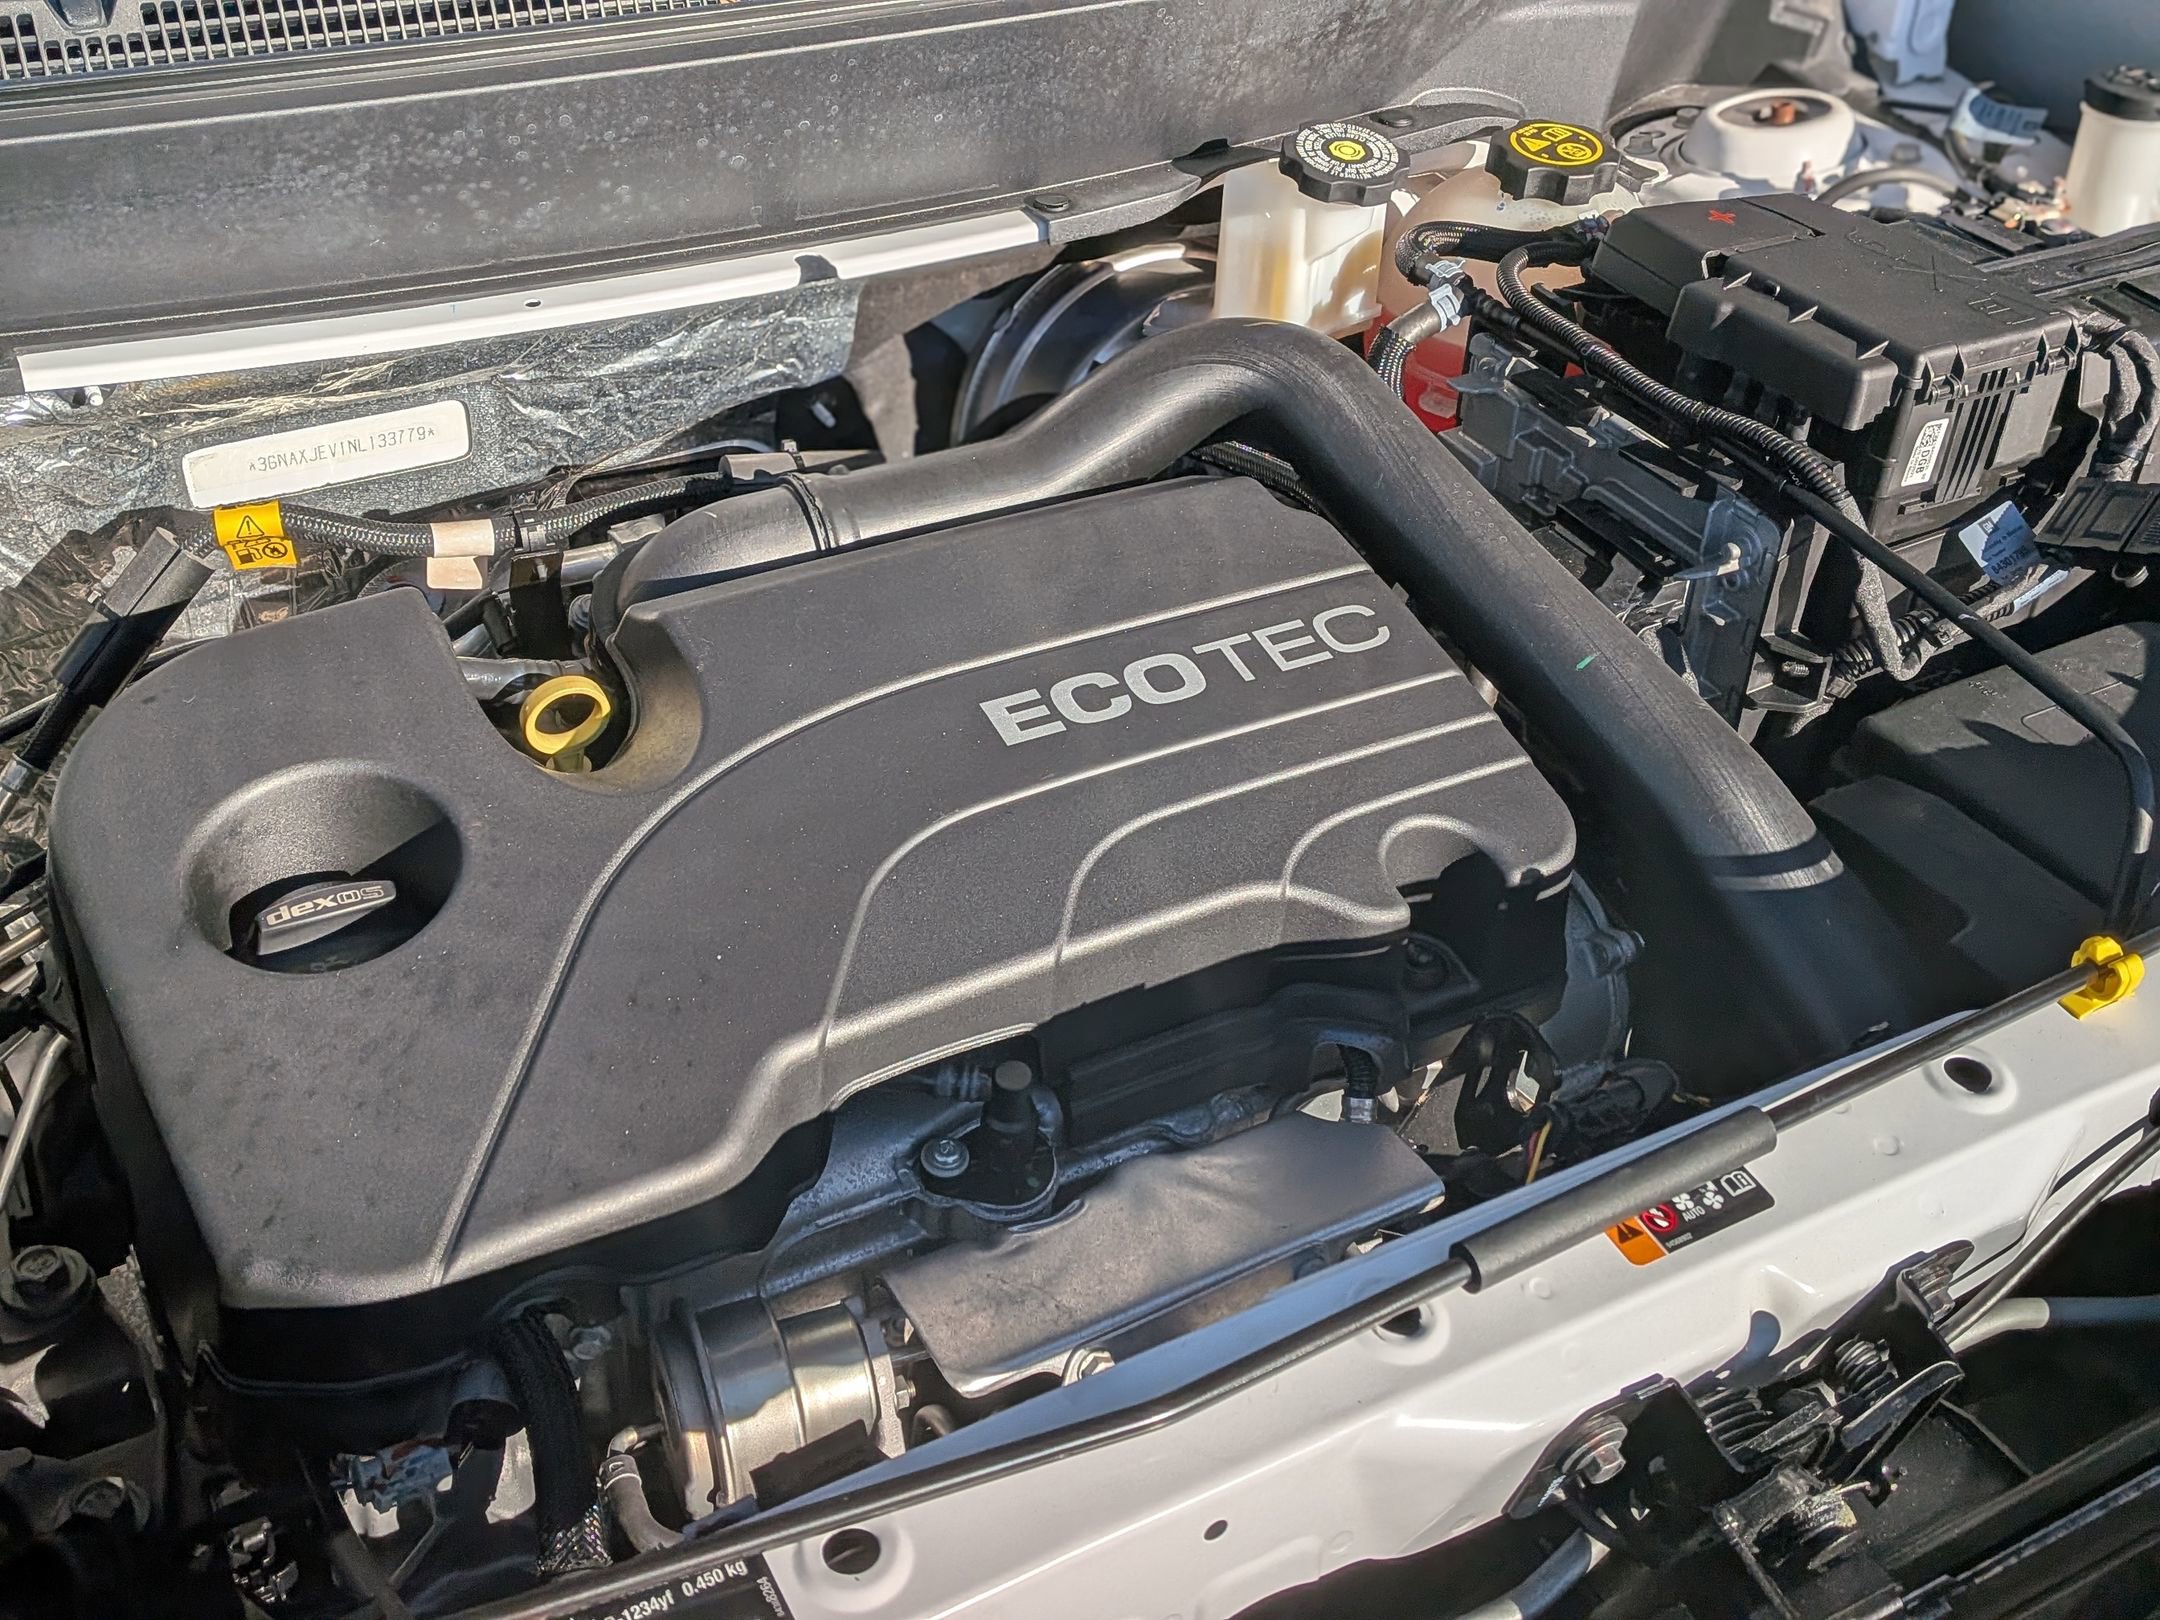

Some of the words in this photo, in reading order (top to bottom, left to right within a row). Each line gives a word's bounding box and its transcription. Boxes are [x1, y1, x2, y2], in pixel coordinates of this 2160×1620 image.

[979, 604, 1391, 747] ECOTEC
[266, 885, 385, 926] dexos
[1682, 1206, 1706, 1222] AUTO
[681, 1568, 725, 1598] 0.450
[724, 1559, 749, 1577] kg
